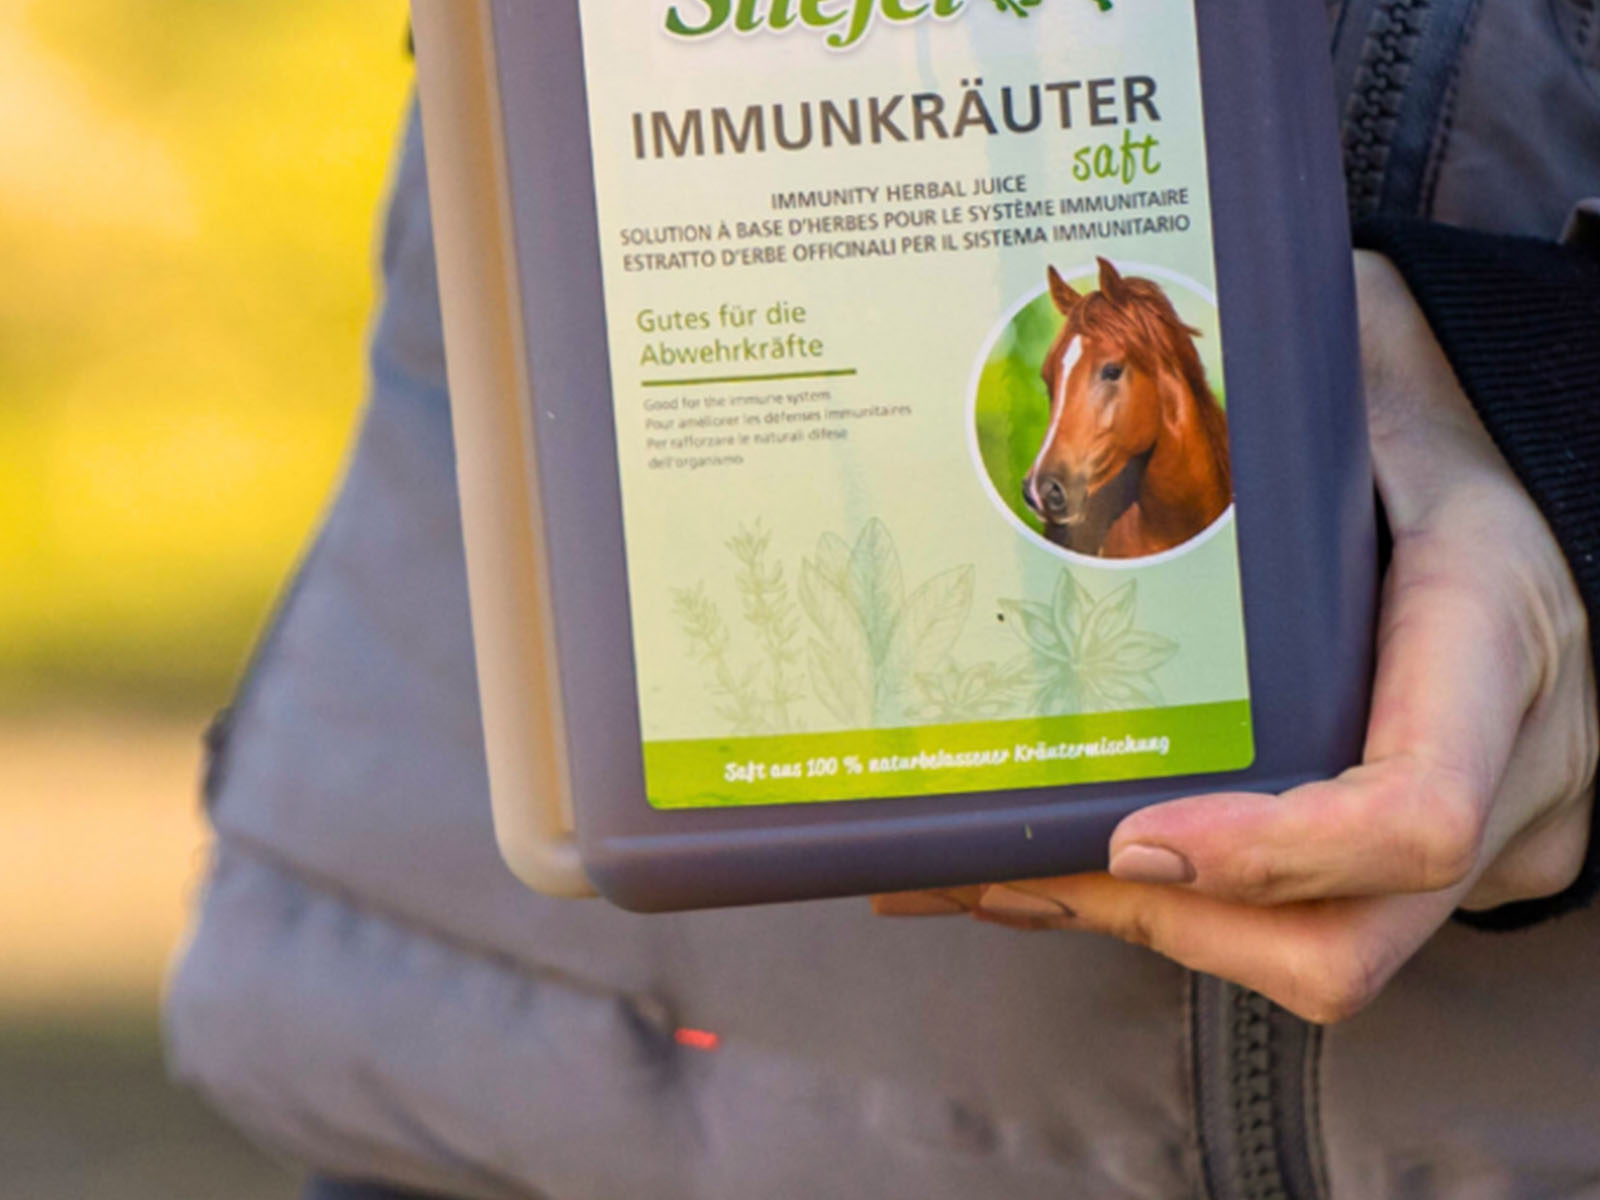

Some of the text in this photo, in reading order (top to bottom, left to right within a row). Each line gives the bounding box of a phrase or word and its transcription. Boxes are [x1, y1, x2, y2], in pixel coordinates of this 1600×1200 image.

[631, 75, 1161, 160] IMMUNKRÄUTER
[1072, 129, 1161, 184] saft
[771, 175, 1027, 210] IMMUNITY HERBAL JUICE
[620, 188, 1189, 246] SOLUTION À BASE D'HERBES POUR LE SYSTÈME IMMUNITAIRE
[622, 214, 1191, 272] ESTRATTO D'ERBE OFFICINALI PER IL SISTEMA IMMUNITARIO
[636, 301, 806, 333] Gutes für die
[640, 333, 824, 366] Abwehrkräfte
[643, 390, 832, 412] Good for the immune system
[645, 417, 675, 431] Pour
[744, 412, 762, 426] les
[824, 404, 912, 421] immunitaires
[646, 437, 668, 451] Per
[737, 432, 750, 445] le
[724, 734, 1170, 783] Saft aus 100 % naturbelassener Kräutermischung
